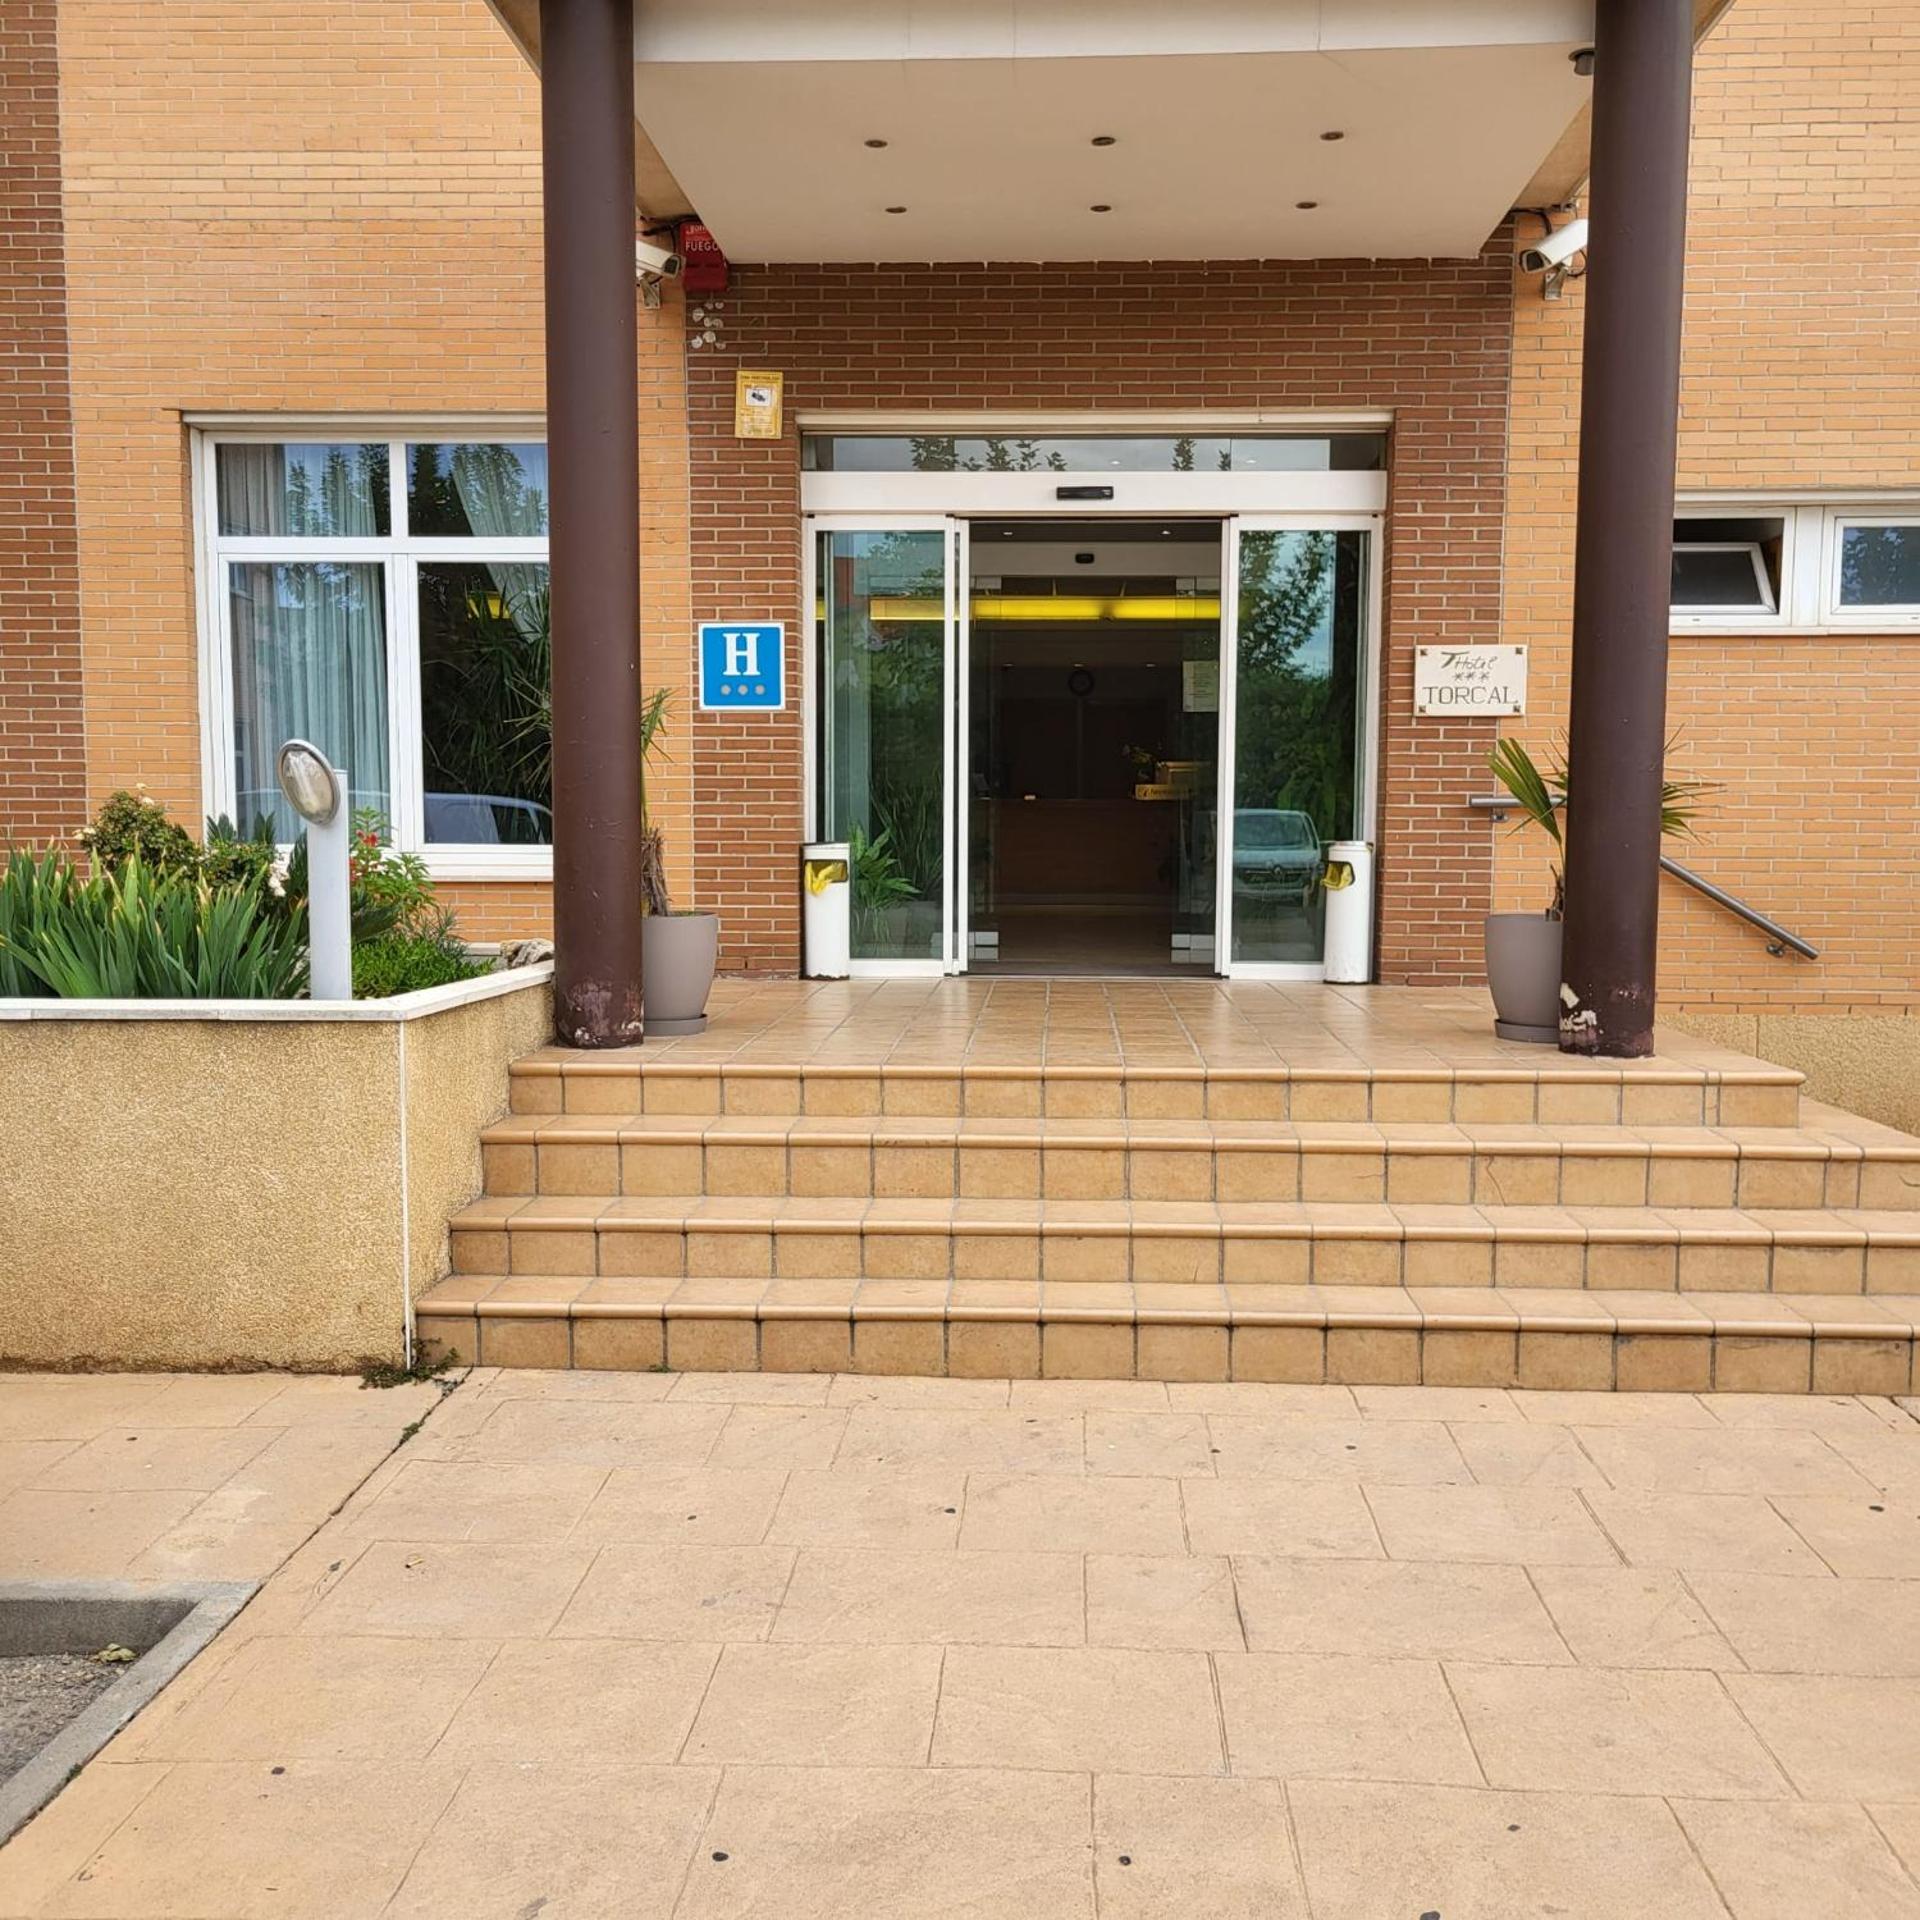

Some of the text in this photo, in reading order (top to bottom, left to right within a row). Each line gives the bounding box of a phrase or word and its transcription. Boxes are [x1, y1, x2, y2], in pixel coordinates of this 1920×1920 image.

[685, 240, 718, 251] FUEGO
[722, 632, 761, 676] H
[1422, 685, 1519, 705] TORCAL
